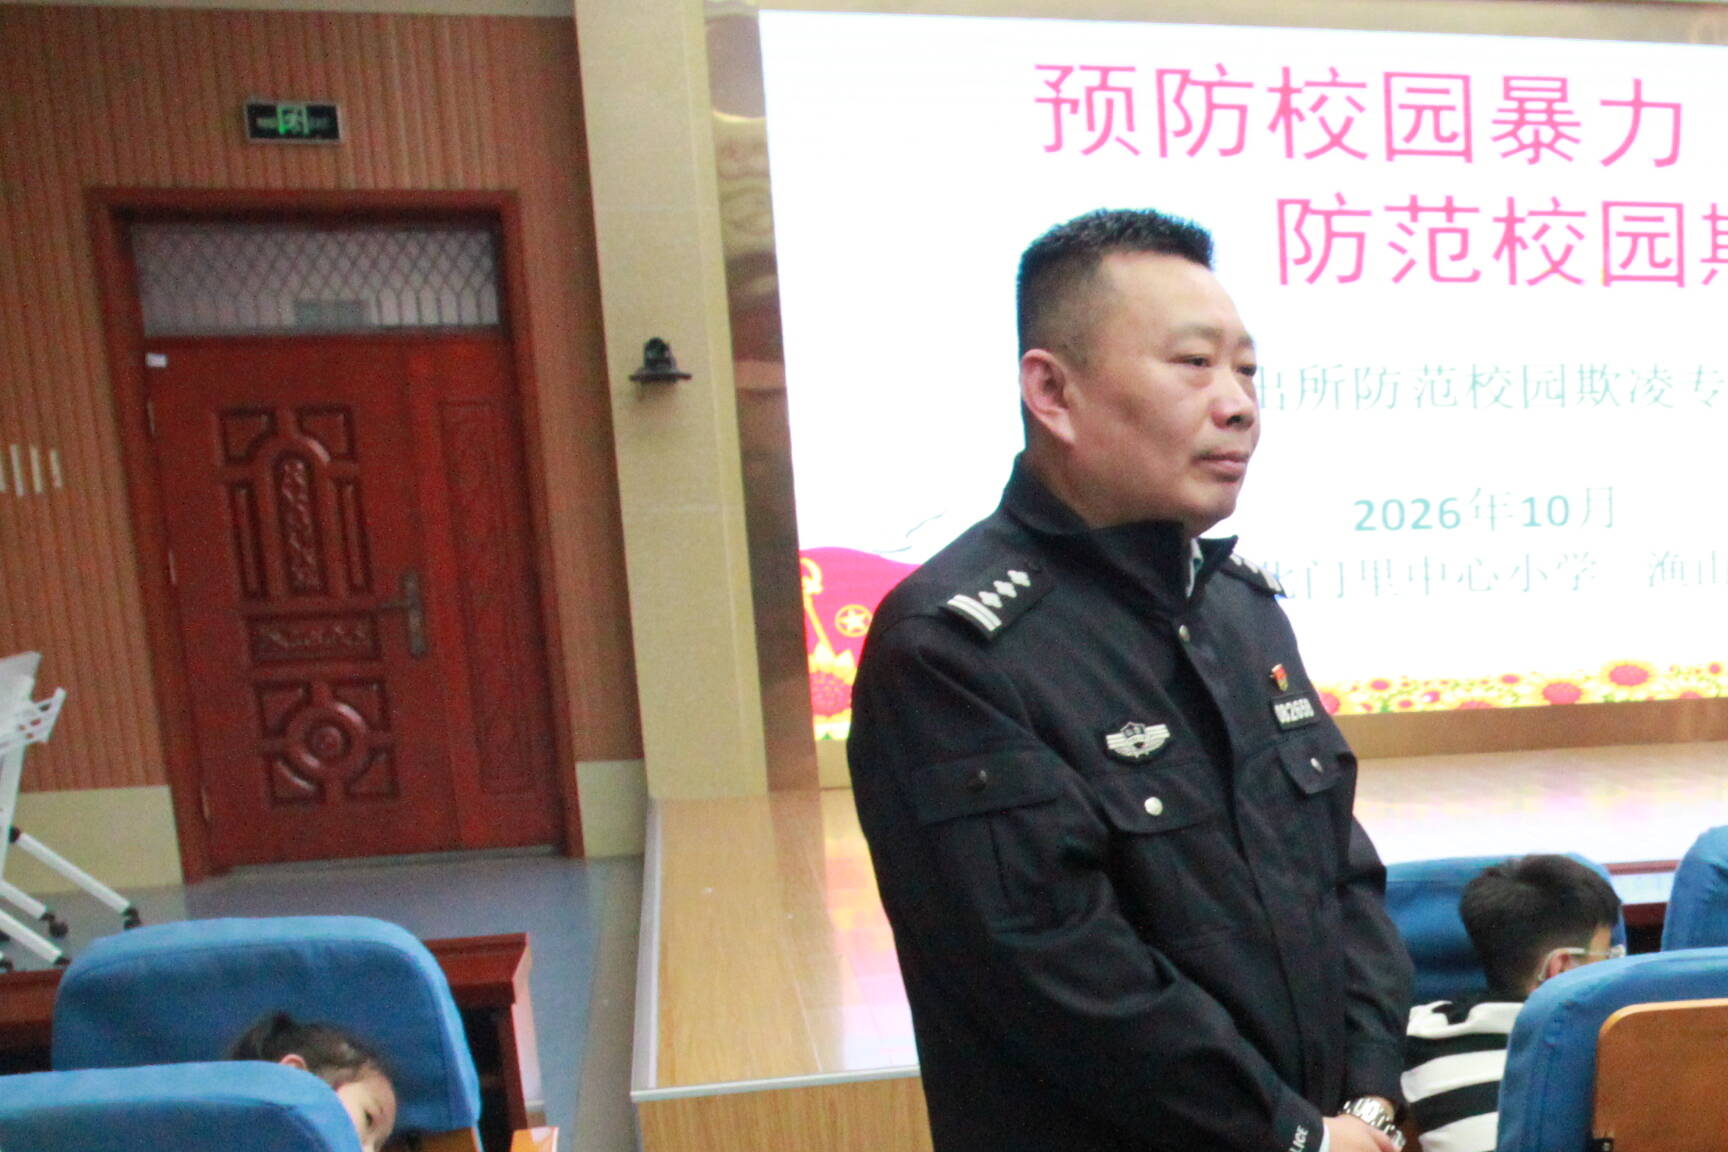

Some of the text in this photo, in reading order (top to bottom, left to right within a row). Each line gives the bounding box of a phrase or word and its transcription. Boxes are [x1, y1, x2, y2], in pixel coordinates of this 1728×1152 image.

[1034, 62, 1684, 168] 预防校园暴力
[1352, 485, 1615, 532] 2026年10月
